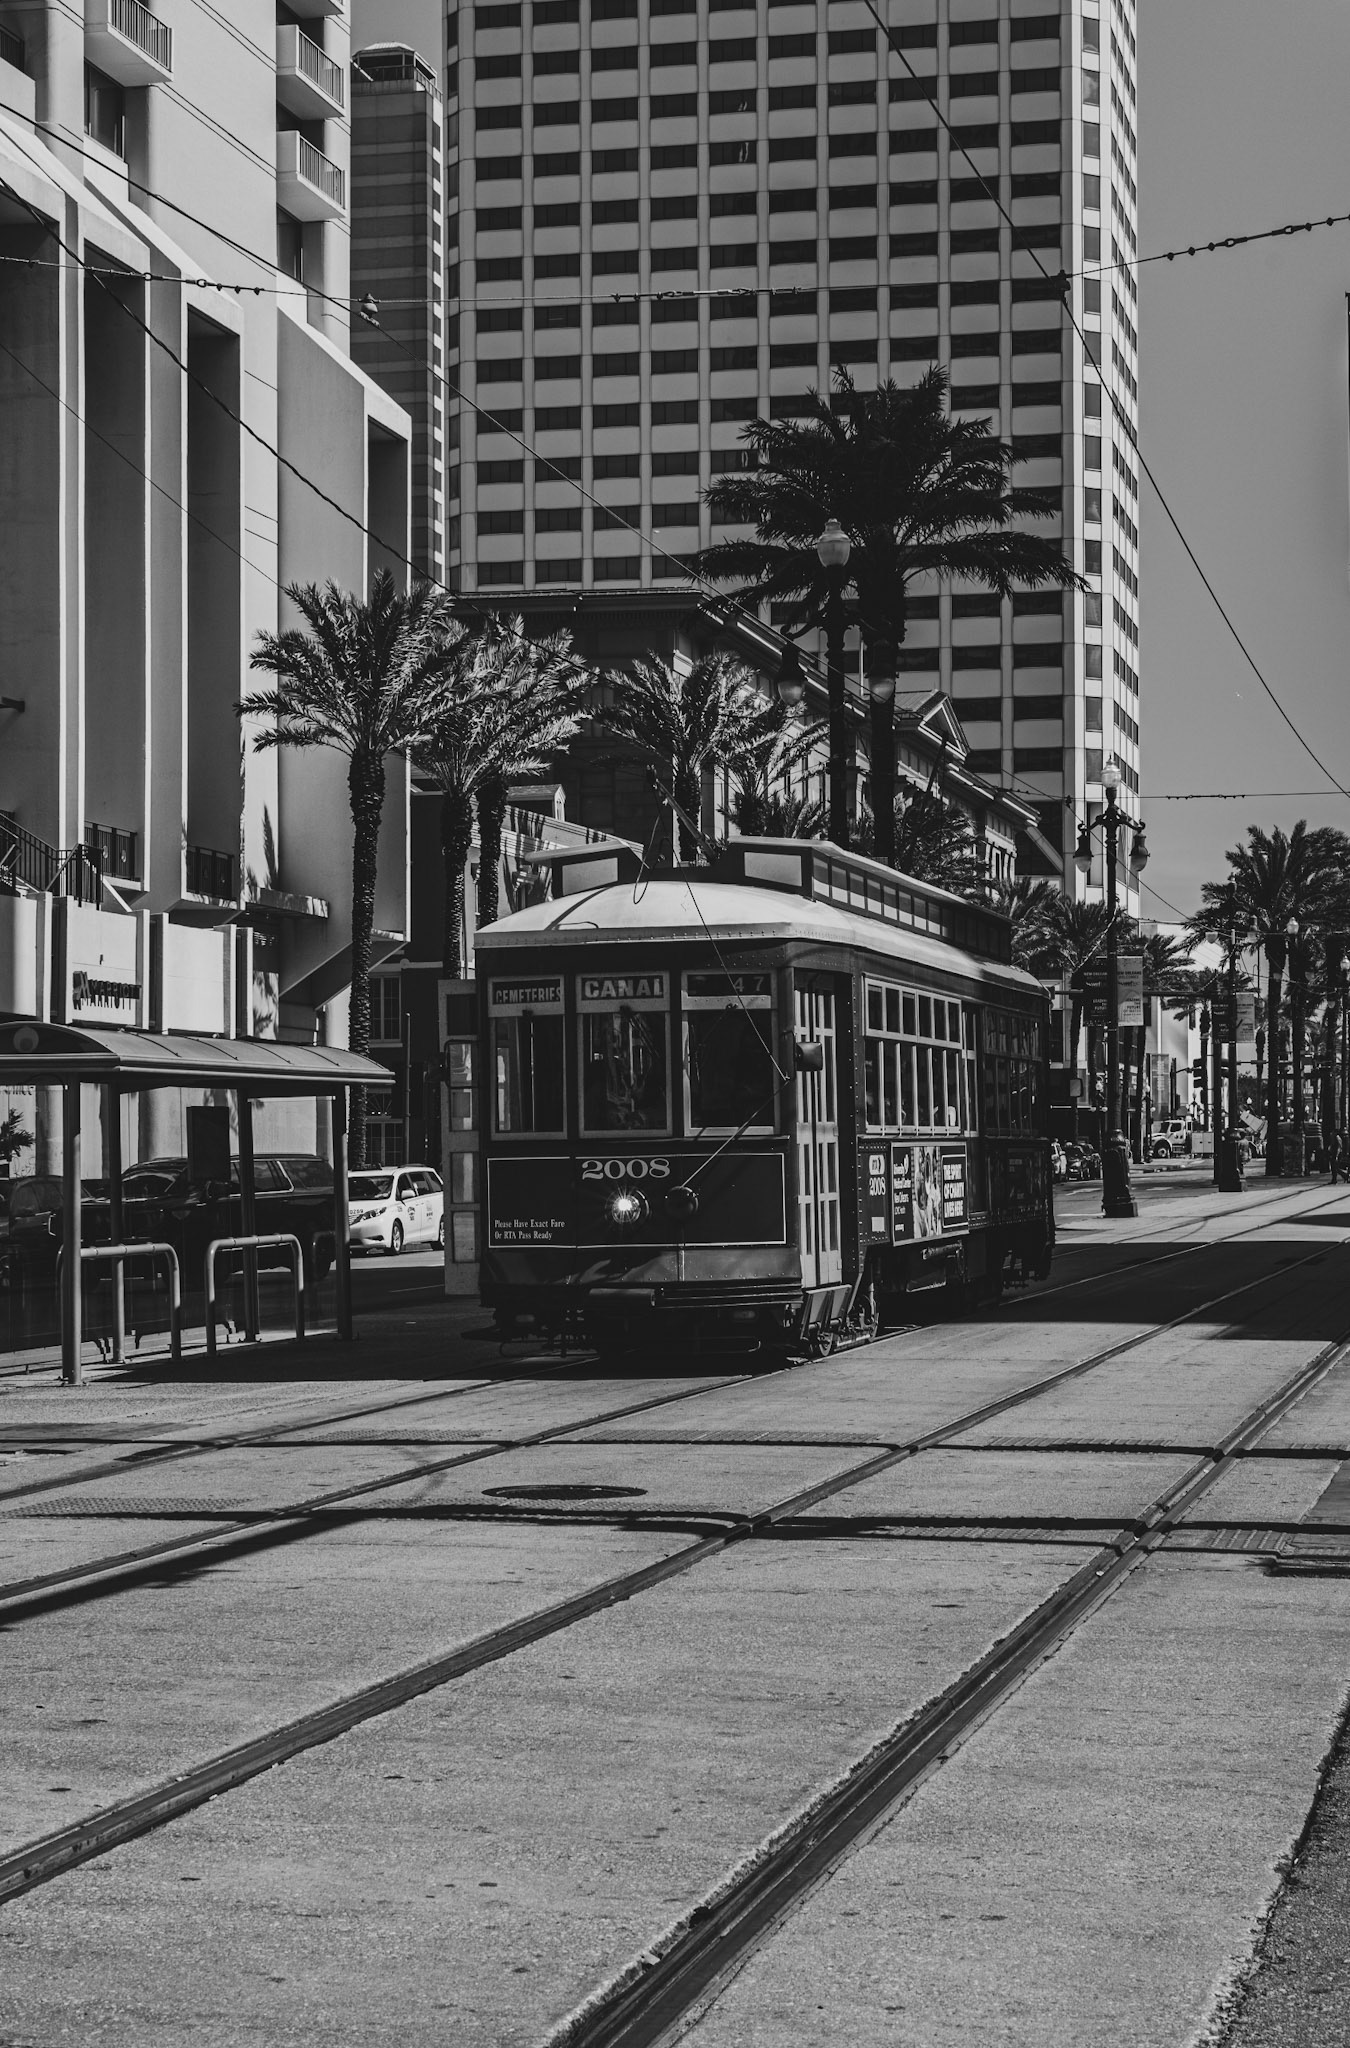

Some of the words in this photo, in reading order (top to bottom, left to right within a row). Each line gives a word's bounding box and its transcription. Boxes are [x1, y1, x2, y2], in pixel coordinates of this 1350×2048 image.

[86, 979, 142, 1003] MARRIOTT
[584, 978, 664, 999] CANAL
[582, 1157, 670, 1180] 2008
[869, 1176, 886, 1196] 2008
[494, 1219, 513, 1228] Please
[514, 1219, 529, 1228] Have
[530, 1218, 549, 1228] Exact
[550, 1218, 567, 1228] Fare
[494, 1231, 502, 1239] Or
[504, 1231, 516, 1239] RTA
[518, 1231, 532, 1239] Pass
[533, 1231, 554, 1241] Ready
